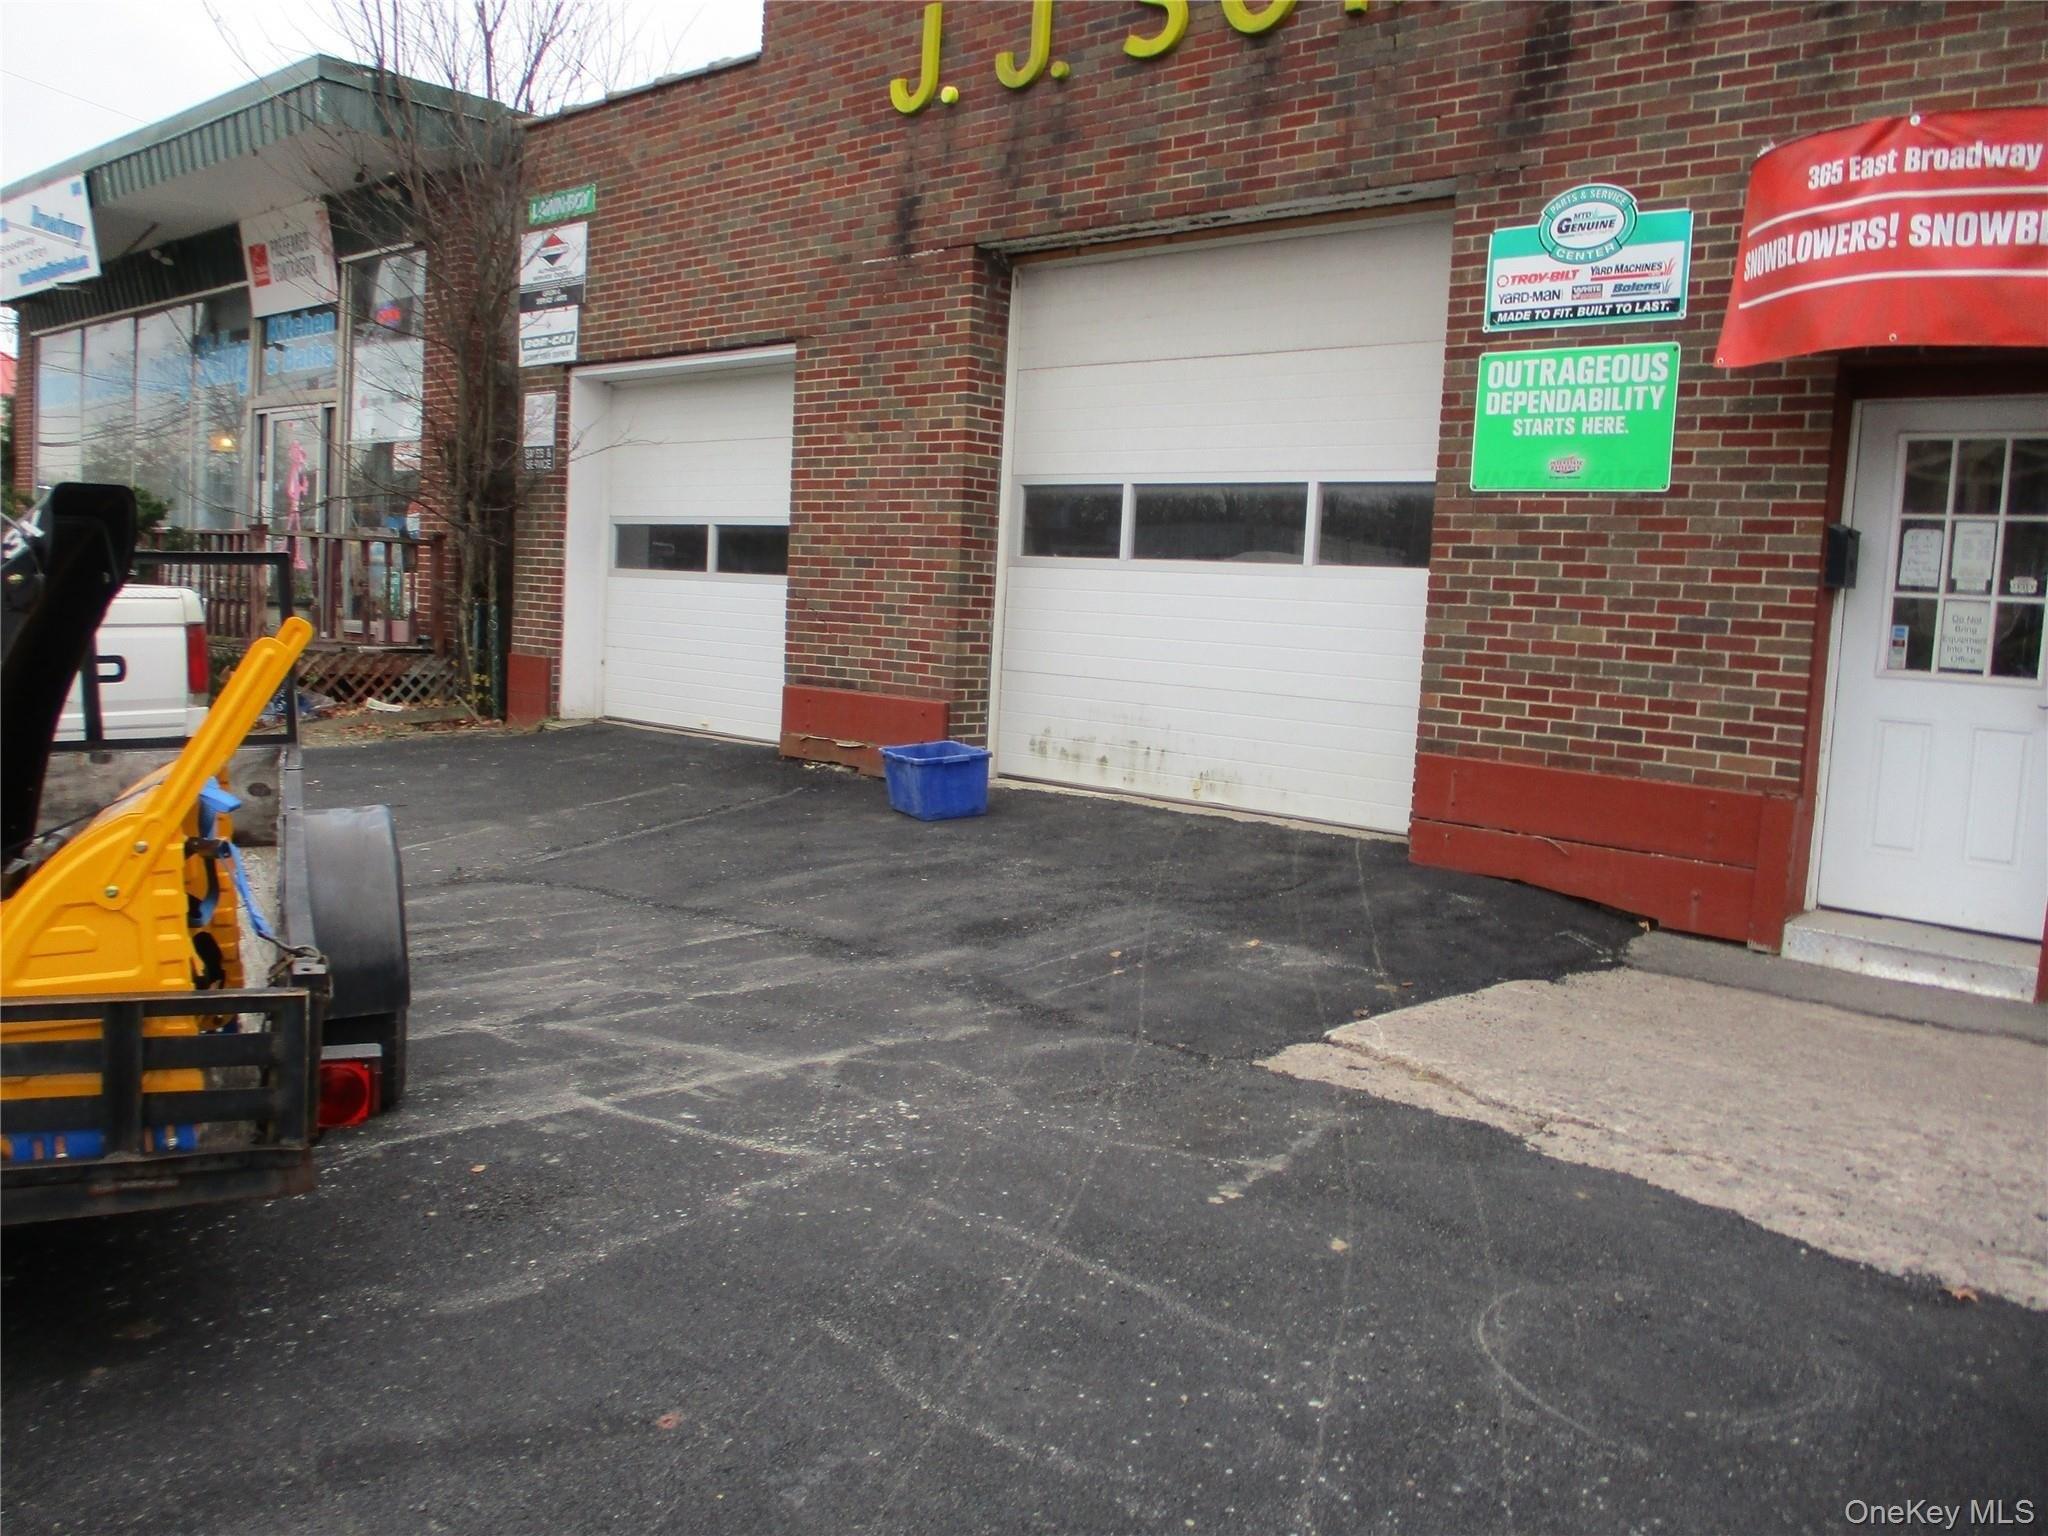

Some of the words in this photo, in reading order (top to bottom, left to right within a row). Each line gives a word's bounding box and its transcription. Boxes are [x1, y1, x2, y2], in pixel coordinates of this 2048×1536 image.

[890, 2, 959, 113] J.
[995, 0, 1070, 89] J.
[1807, 159, 1843, 190] 365
[1849, 151, 1898, 182] East
[1903, 140, 2043, 172] Broadway
[1549, 191, 1578, 215] PARTS
[1579, 190, 1587, 200] &
[1589, 189, 1629, 208] SERVICE
[1556, 217, 1617, 235] GENUINE
[1573, 211, 1592, 220] MTD
[1555, 243, 1615, 261] CENTER
[1743, 212, 1900, 282] SNOWBLOWERS!
[1509, 268, 1580, 286] TROY-BILT
[1590, 265, 1613, 276] YARD
[1613, 262, 1663, 275] MACHINES
[1612, 281, 1661, 293] Bolens
[1497, 311, 1531, 323] MADE
[1534, 309, 1551, 321] TO
[1552, 308, 1574, 319] FIT.
[1577, 304, 1610, 317] BUILT
[1615, 303, 1632, 314] TO
[1635, 300, 1670, 313] LAST.
[1486, 351, 1669, 389] OUTRAGEOUS
[1485, 385, 1666, 416] DEPENDABILITY
[1512, 416, 1576, 436] STARTS
[1581, 415, 1629, 435] HERE.
